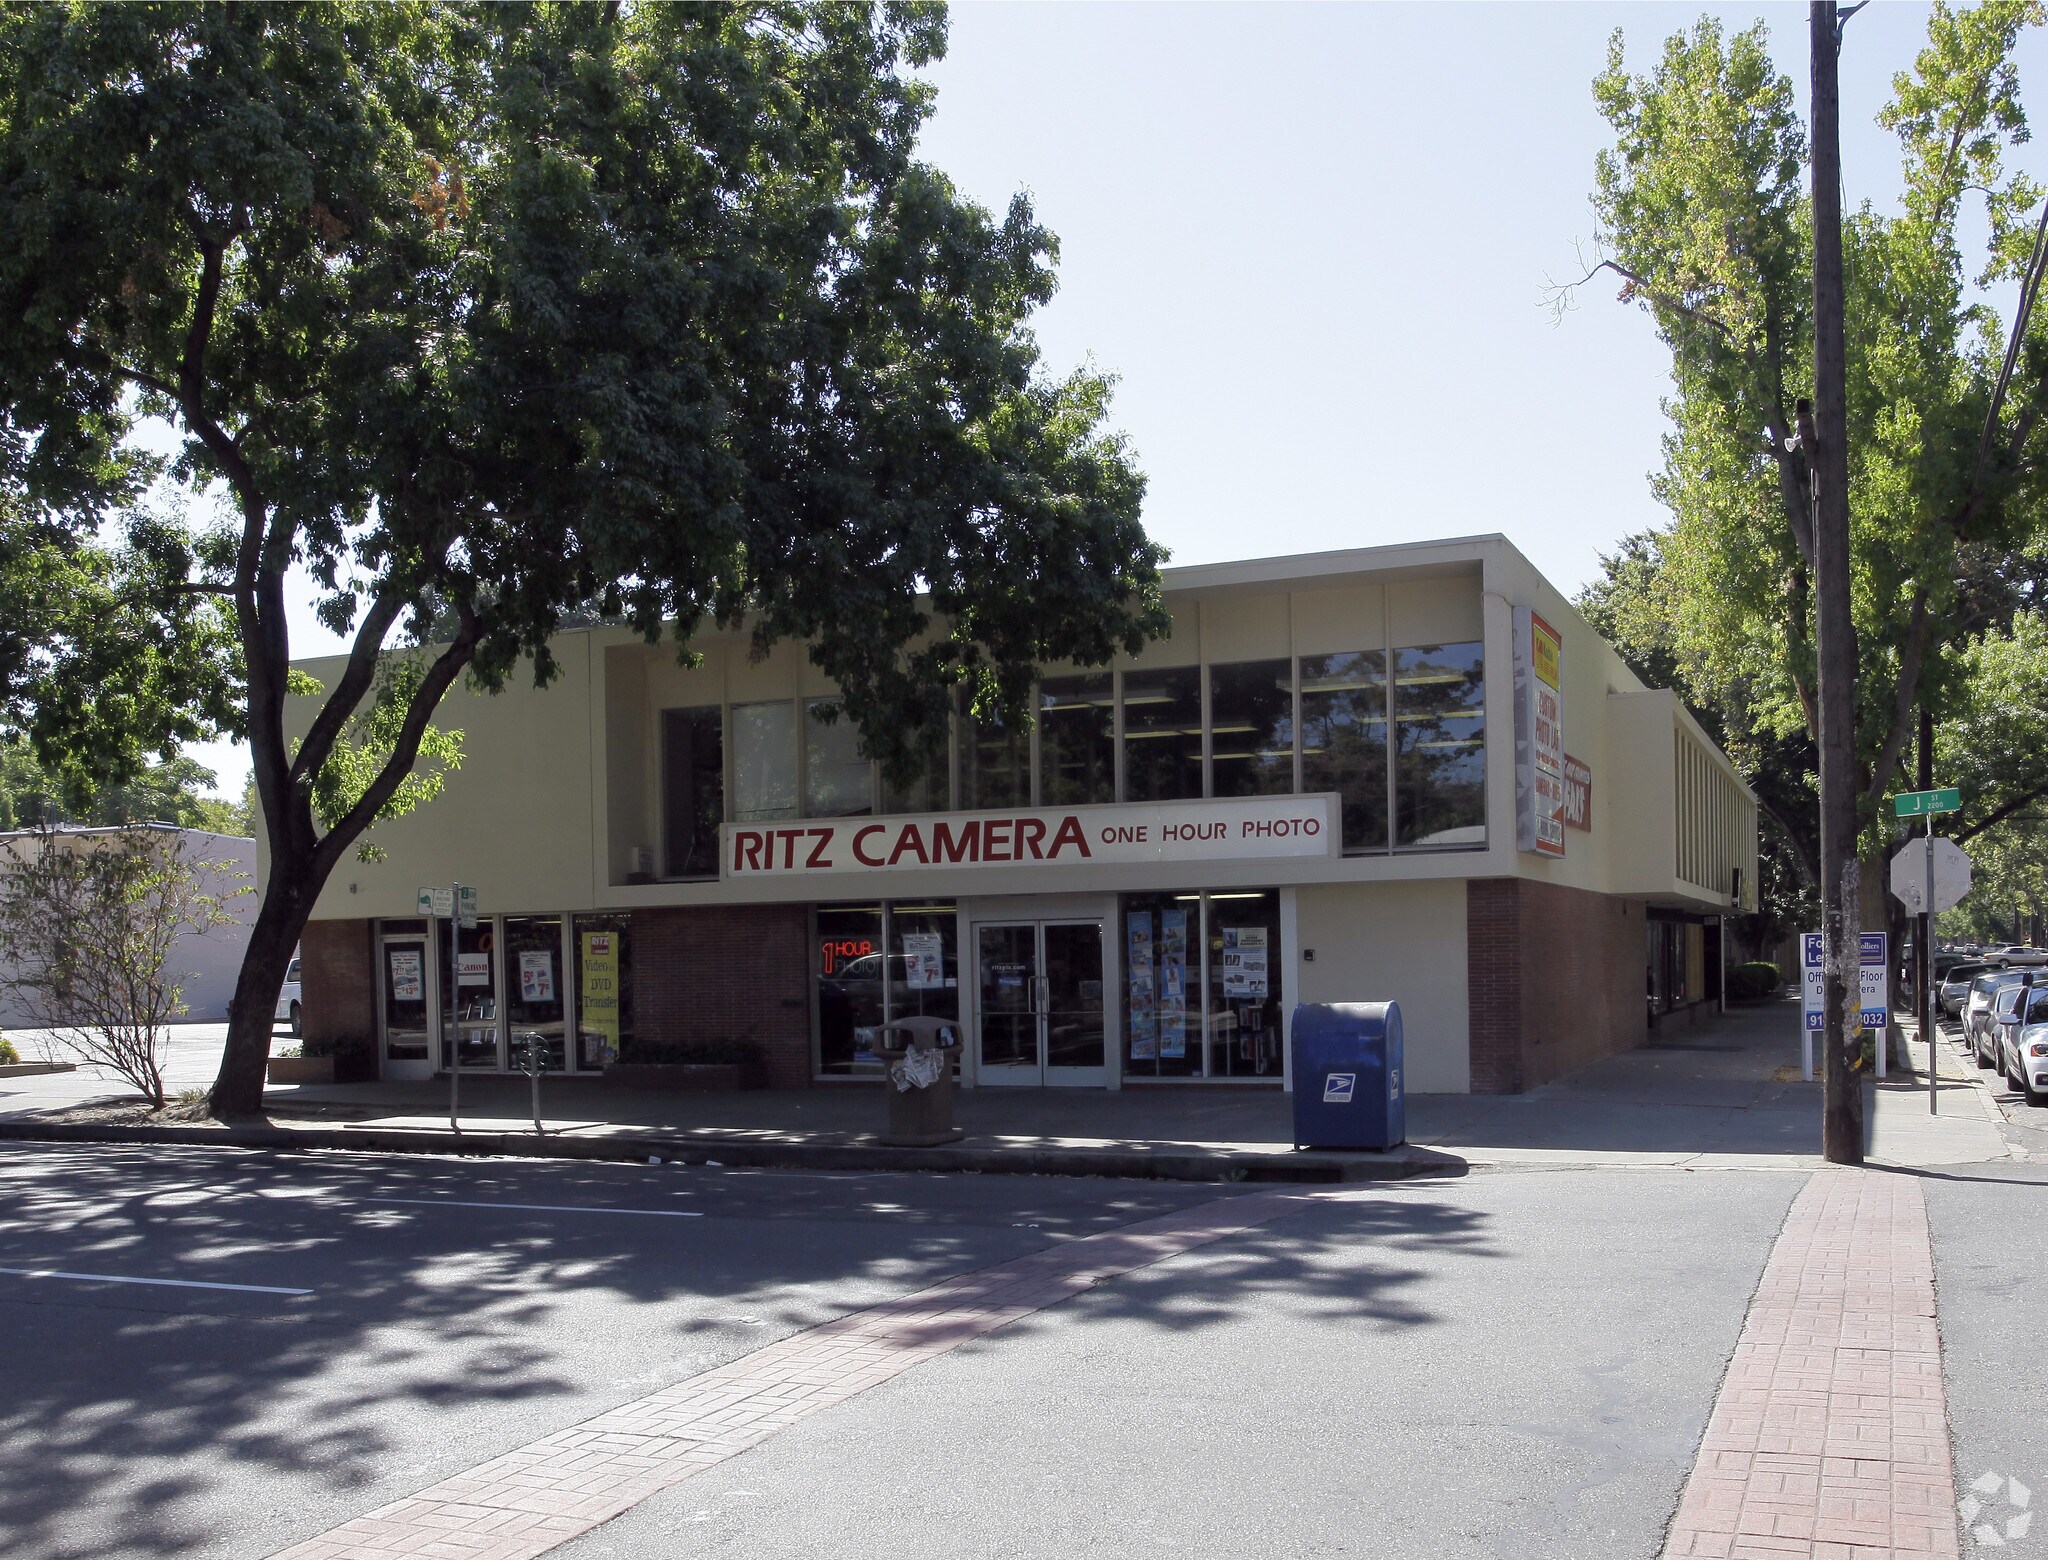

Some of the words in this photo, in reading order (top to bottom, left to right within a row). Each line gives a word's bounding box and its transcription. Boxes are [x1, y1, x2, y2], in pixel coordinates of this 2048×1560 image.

[1912, 796, 1921, 811] J
[1101, 825, 1148, 844] ONE
[1162, 822, 1227, 841] HOUR
[1242, 818, 1321, 838] PHOTO
[733, 827, 835, 871] RITZ
[852, 815, 1093, 867] CAMERA
[1808, 937, 1823, 949] Fo
[821, 942, 834, 974] 1
[835, 941, 872, 956] HOUR
[457, 963, 487, 972] Canon
[584, 959, 608, 972] Video
[835, 959, 877, 973] PHOTO
[1807, 971, 1824, 983] Offi
[1860, 971, 1884, 981] Floor
[591, 978, 612, 990] DVD
[584, 996, 618, 1009] Transfer
